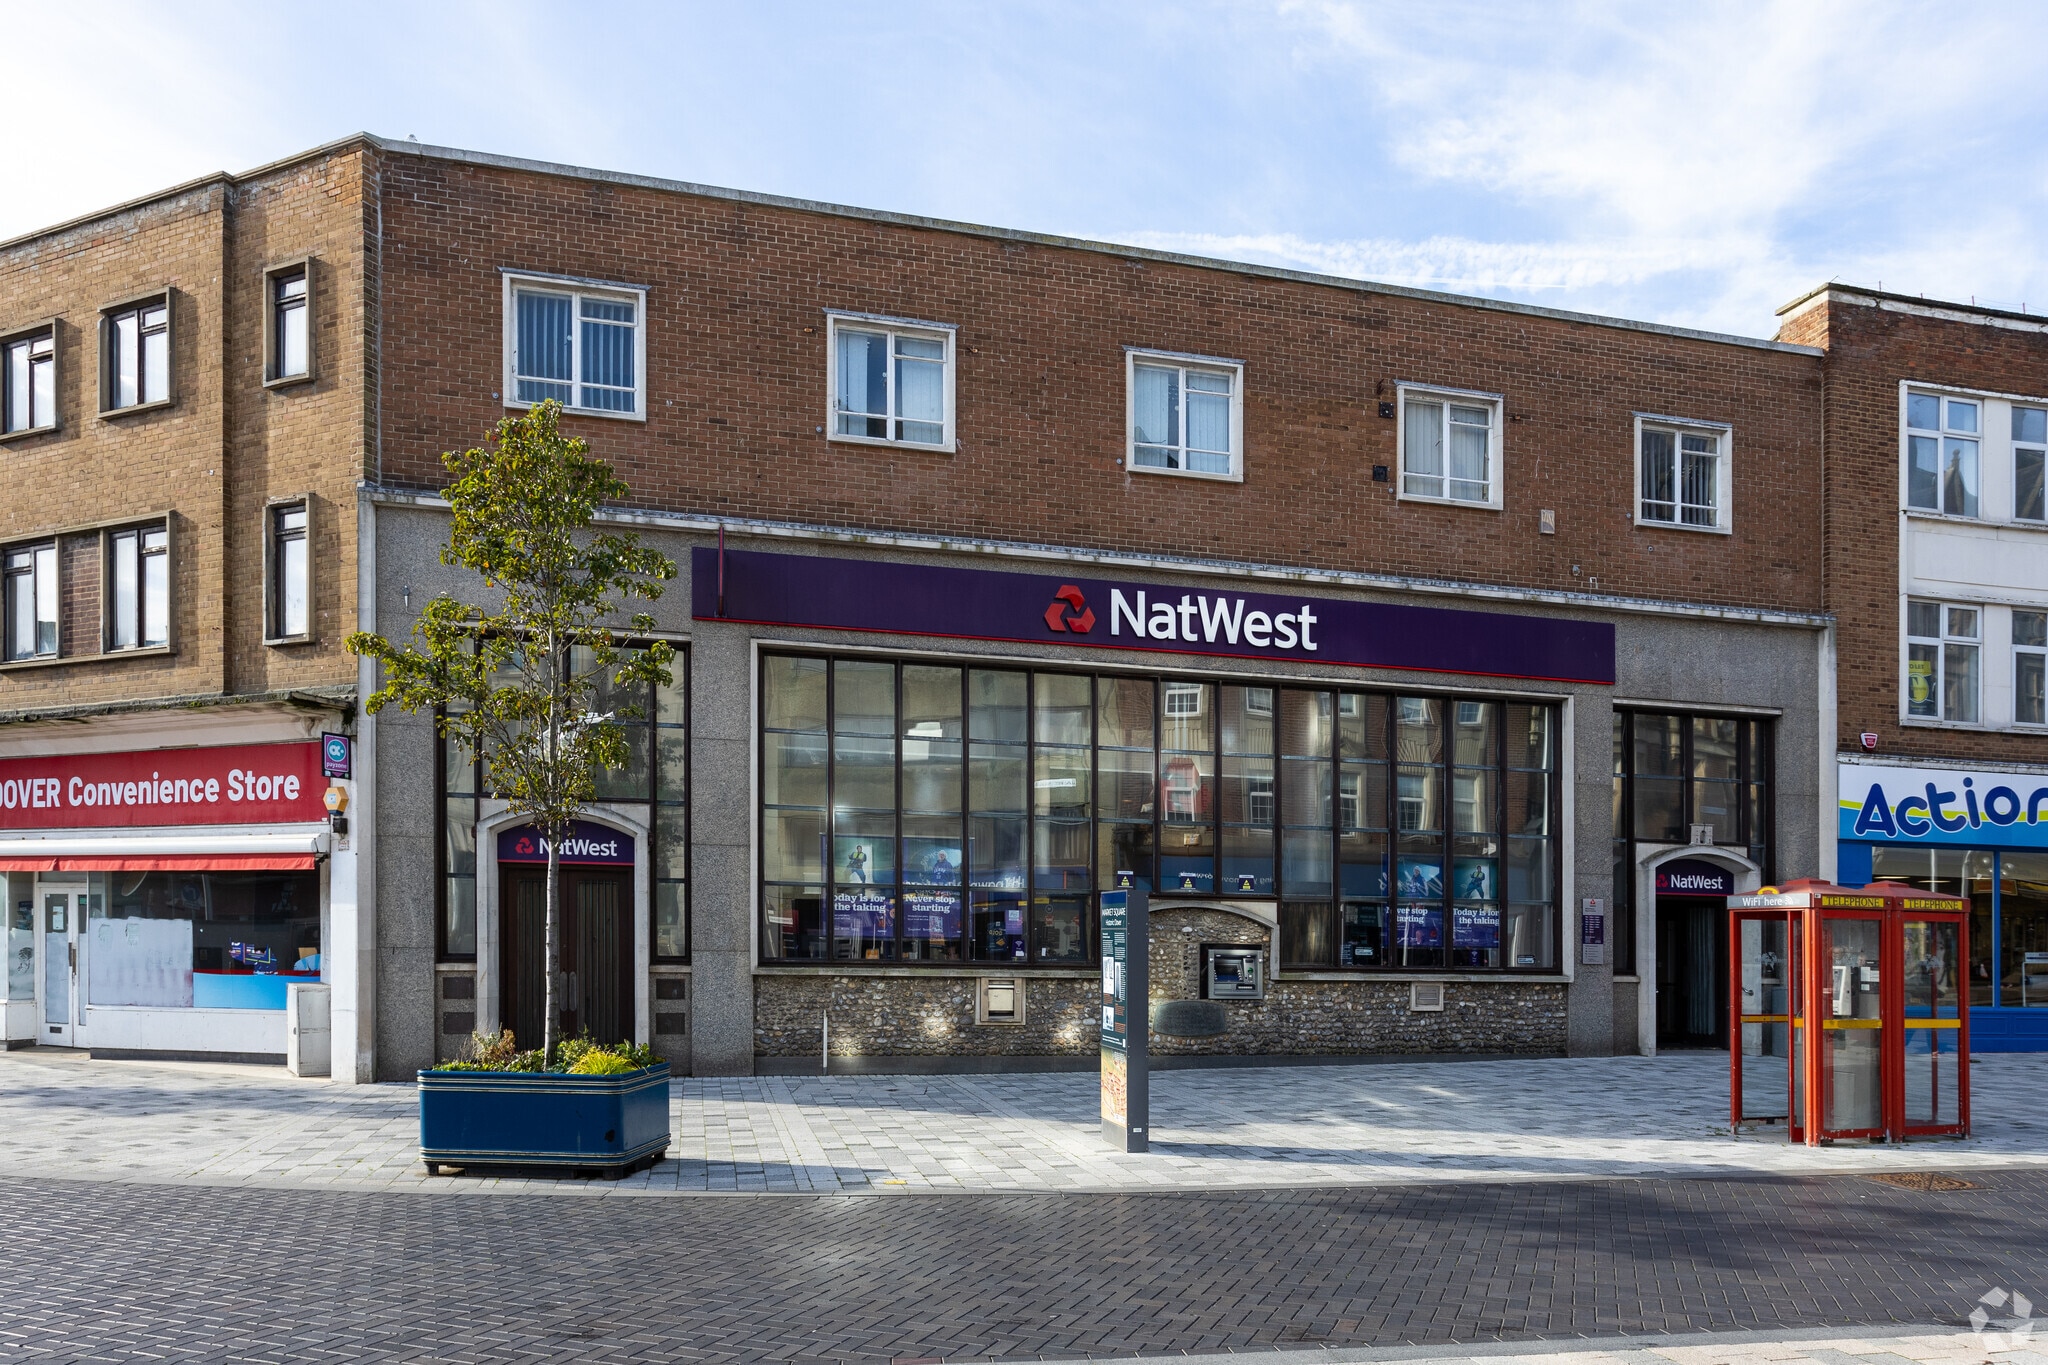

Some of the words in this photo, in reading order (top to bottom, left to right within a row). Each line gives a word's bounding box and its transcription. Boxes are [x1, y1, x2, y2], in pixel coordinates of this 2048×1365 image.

[1110, 588, 1318, 651] NatWest
[326, 761, 347, 769] payzone
[0, 777, 61, 809] OVER
[68, 771, 220, 807] Convenience
[227, 768, 300, 802] Store
[1670, 874, 1723, 890] NatWest
[834, 893, 858, 904] oday
[859, 893, 868, 902] is
[870, 893, 886, 903] for
[906, 895, 934, 903] Never
[935, 895, 956, 905] stop
[1742, 897, 1761, 907] WiFi
[1763, 897, 1783, 906] here
[1827, 896, 1880, 907] TELEPHONE
[834, 902, 851, 911] the
[852, 902, 887, 914] taking
[912, 903, 951, 914] starting
[1908, 899, 1960, 910] TELEPHONE
[1113, 907, 1126, 917] SQUARE
[1411, 907, 1429, 916] stop
[1453, 907, 1478, 917] Today
[1479, 908, 1486, 916] is
[1397, 915, 1425, 925] tarting
[1459, 916, 1473, 924] the
[1473, 917, 1500, 926] taking
